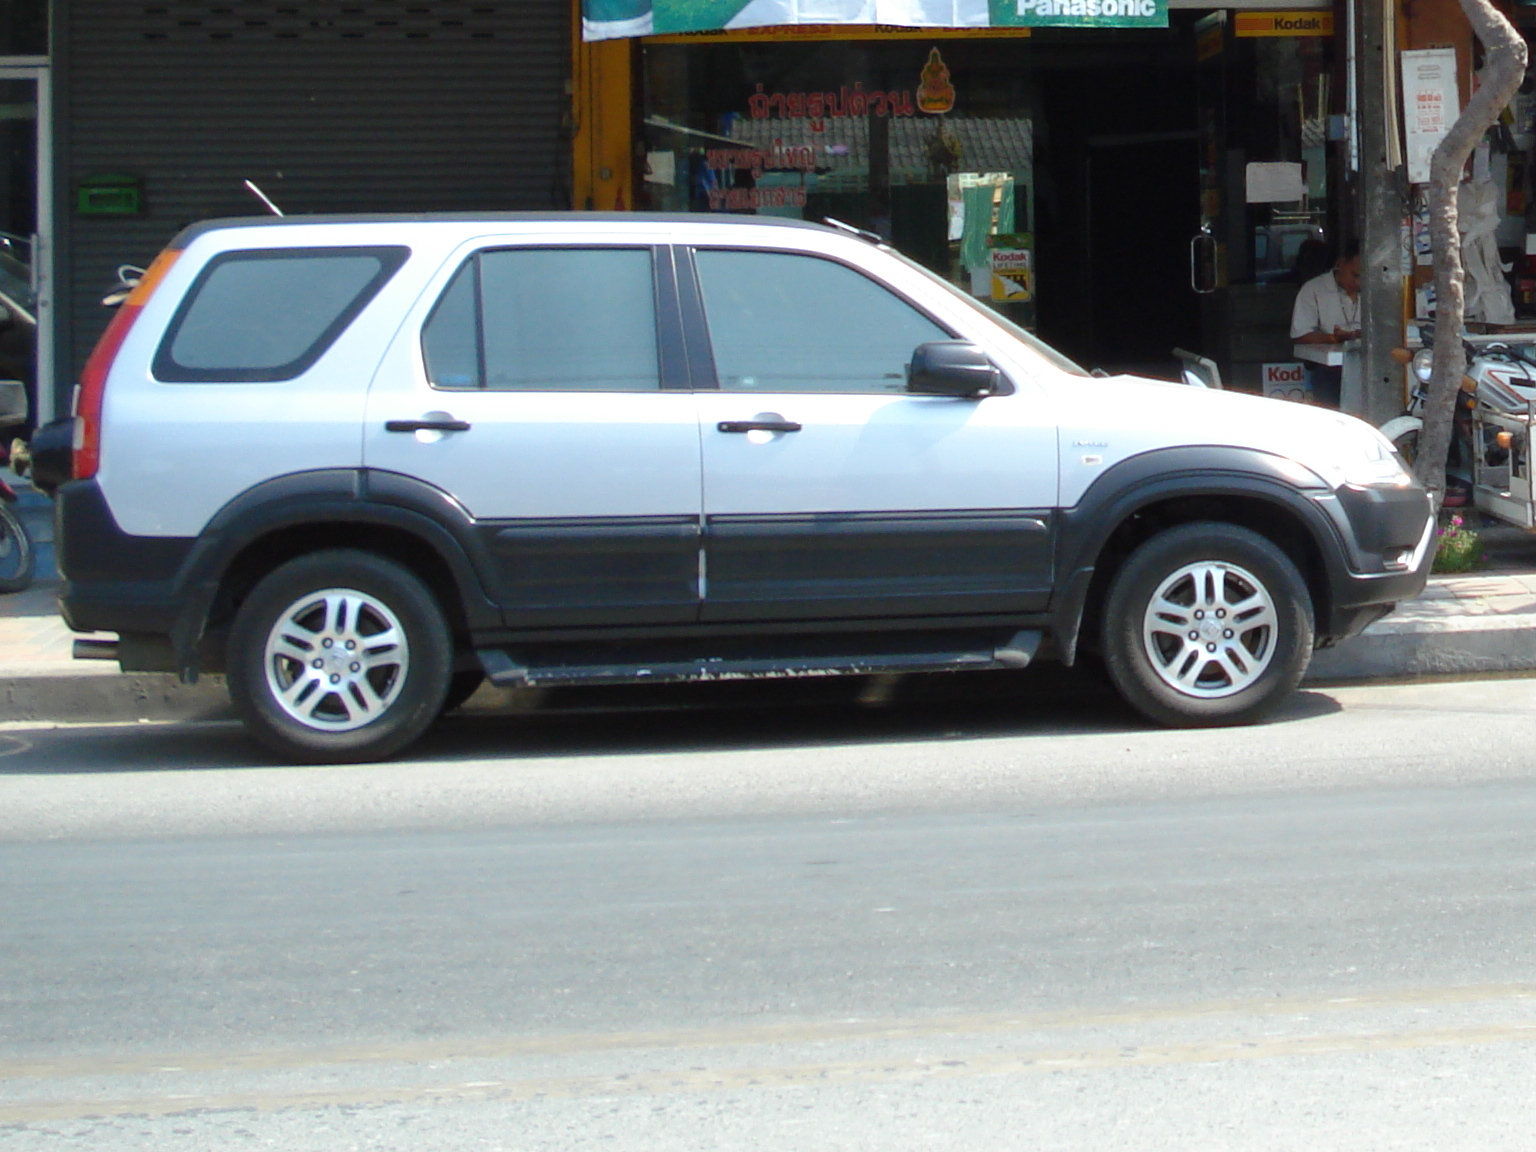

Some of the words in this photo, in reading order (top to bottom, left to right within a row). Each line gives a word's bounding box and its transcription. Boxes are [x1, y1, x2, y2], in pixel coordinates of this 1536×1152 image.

[1274, 10, 1321, 30] Kodak
[748, 81, 914, 132] ถ่ายรูปด่วน
[993, 252, 1027, 261] Kodak
[1268, 366, 1305, 382] Kod
